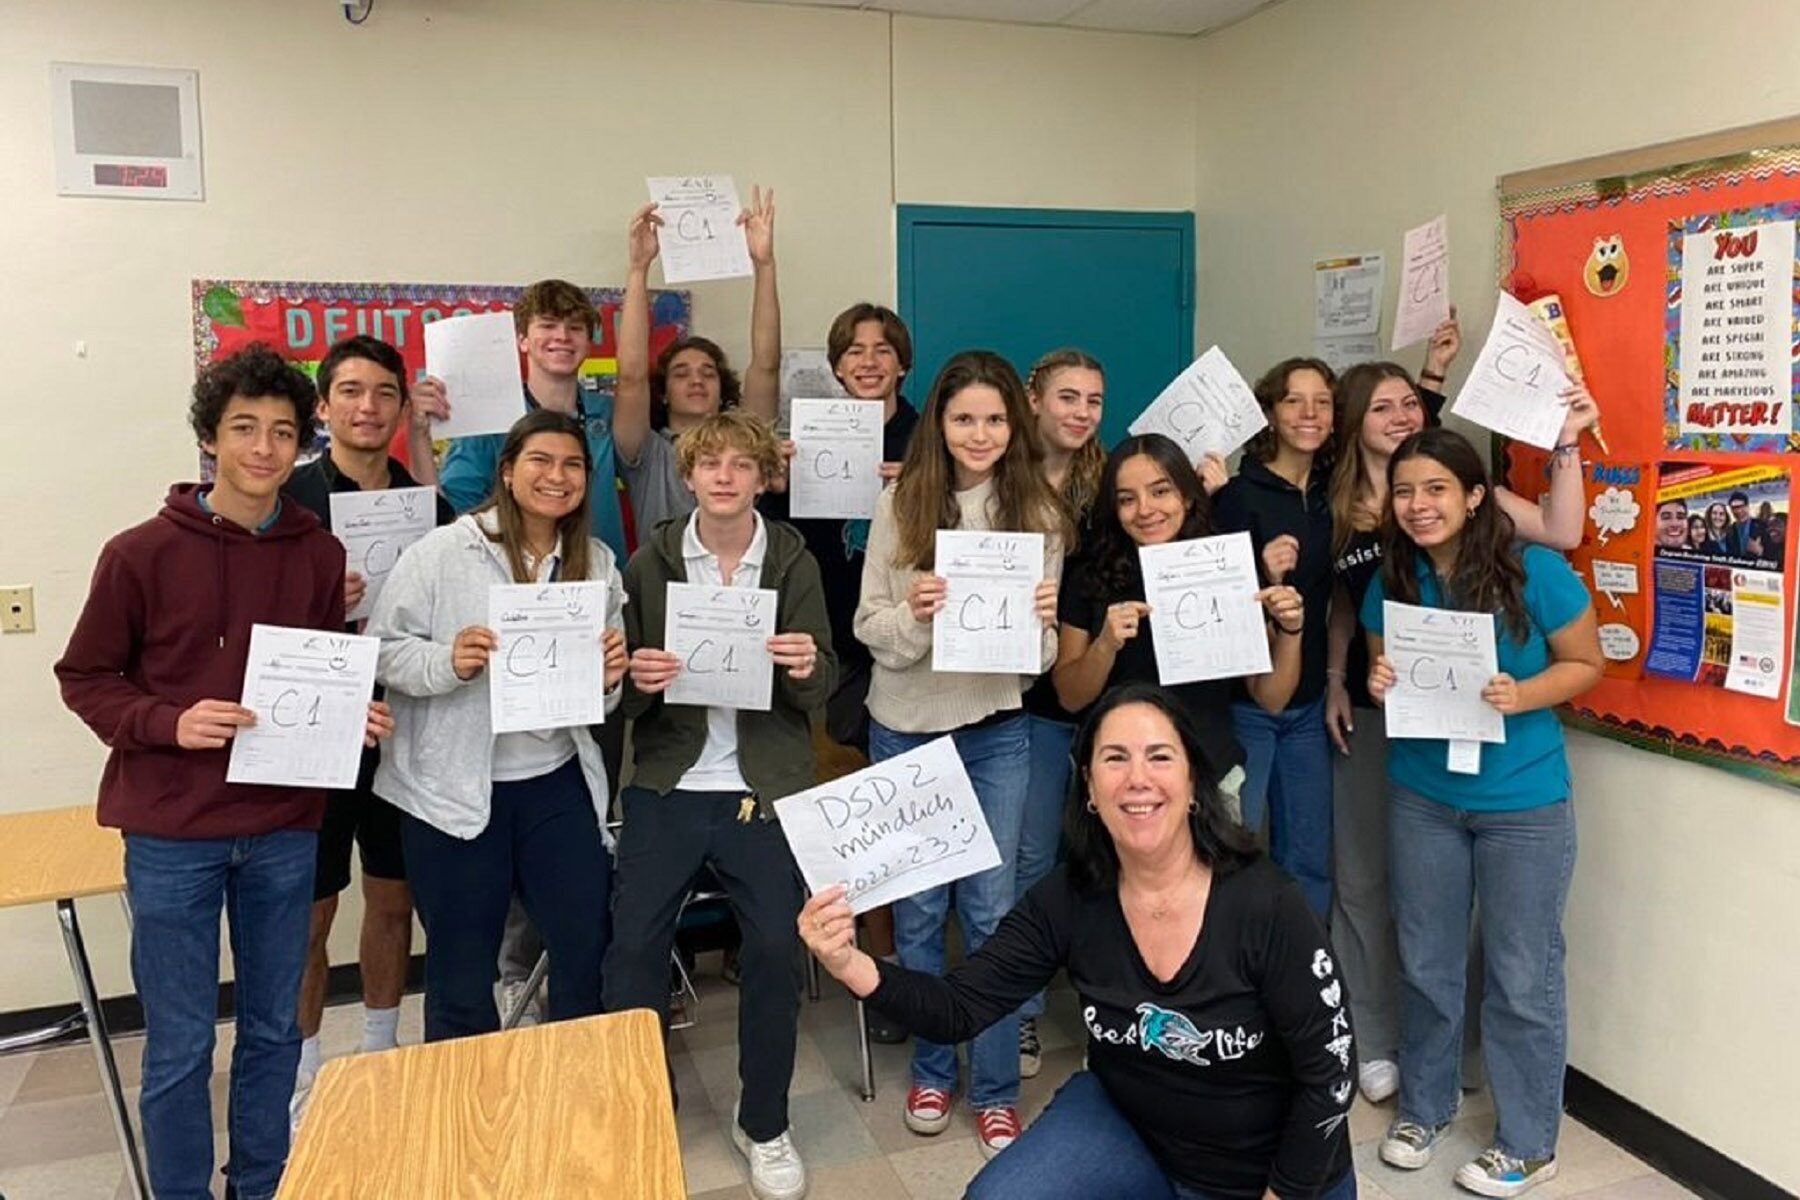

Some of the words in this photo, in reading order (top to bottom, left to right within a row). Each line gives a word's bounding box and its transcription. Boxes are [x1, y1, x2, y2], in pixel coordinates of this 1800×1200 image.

[677, 209, 716, 241] C1
[1714, 229, 1758, 260] YOU
[1412, 265, 1440, 303] C1
[1707, 265, 1725, 275] ARE
[1731, 261, 1764, 273] SUPER
[1704, 283, 1721, 293] ARE
[1727, 279, 1765, 291] UNIQUE
[1705, 301, 1724, 311] ARE
[1730, 296, 1763, 309] SMART
[1703, 317, 1721, 327] ARE
[1702, 335, 1720, 345] ARE
[1726, 332, 1764, 344] SPECIAL
[1495, 344, 1541, 389] C1
[1702, 352, 1720, 361] ARE
[1726, 351, 1764, 361] STRONG
[1699, 369, 1716, 379] ARE
[1721, 368, 1766, 379] AMAZING
[1691, 386, 1709, 396] ARE
[1686, 401, 1783, 428] MATTER!
[814, 449, 853, 480] C1
[960, 593, 1012, 632] C1
[1175, 590, 1223, 630] C1
[506, 634, 558, 677] C1
[687, 639, 739, 674] C1
[1410, 656, 1457, 691] C1
[271, 688, 322, 728] C1
[815, 776, 897, 830] DSD
[906, 764, 938, 788] 2
[832, 793, 954, 859] mündlich
[1216, 1025, 1264, 1061] Life
